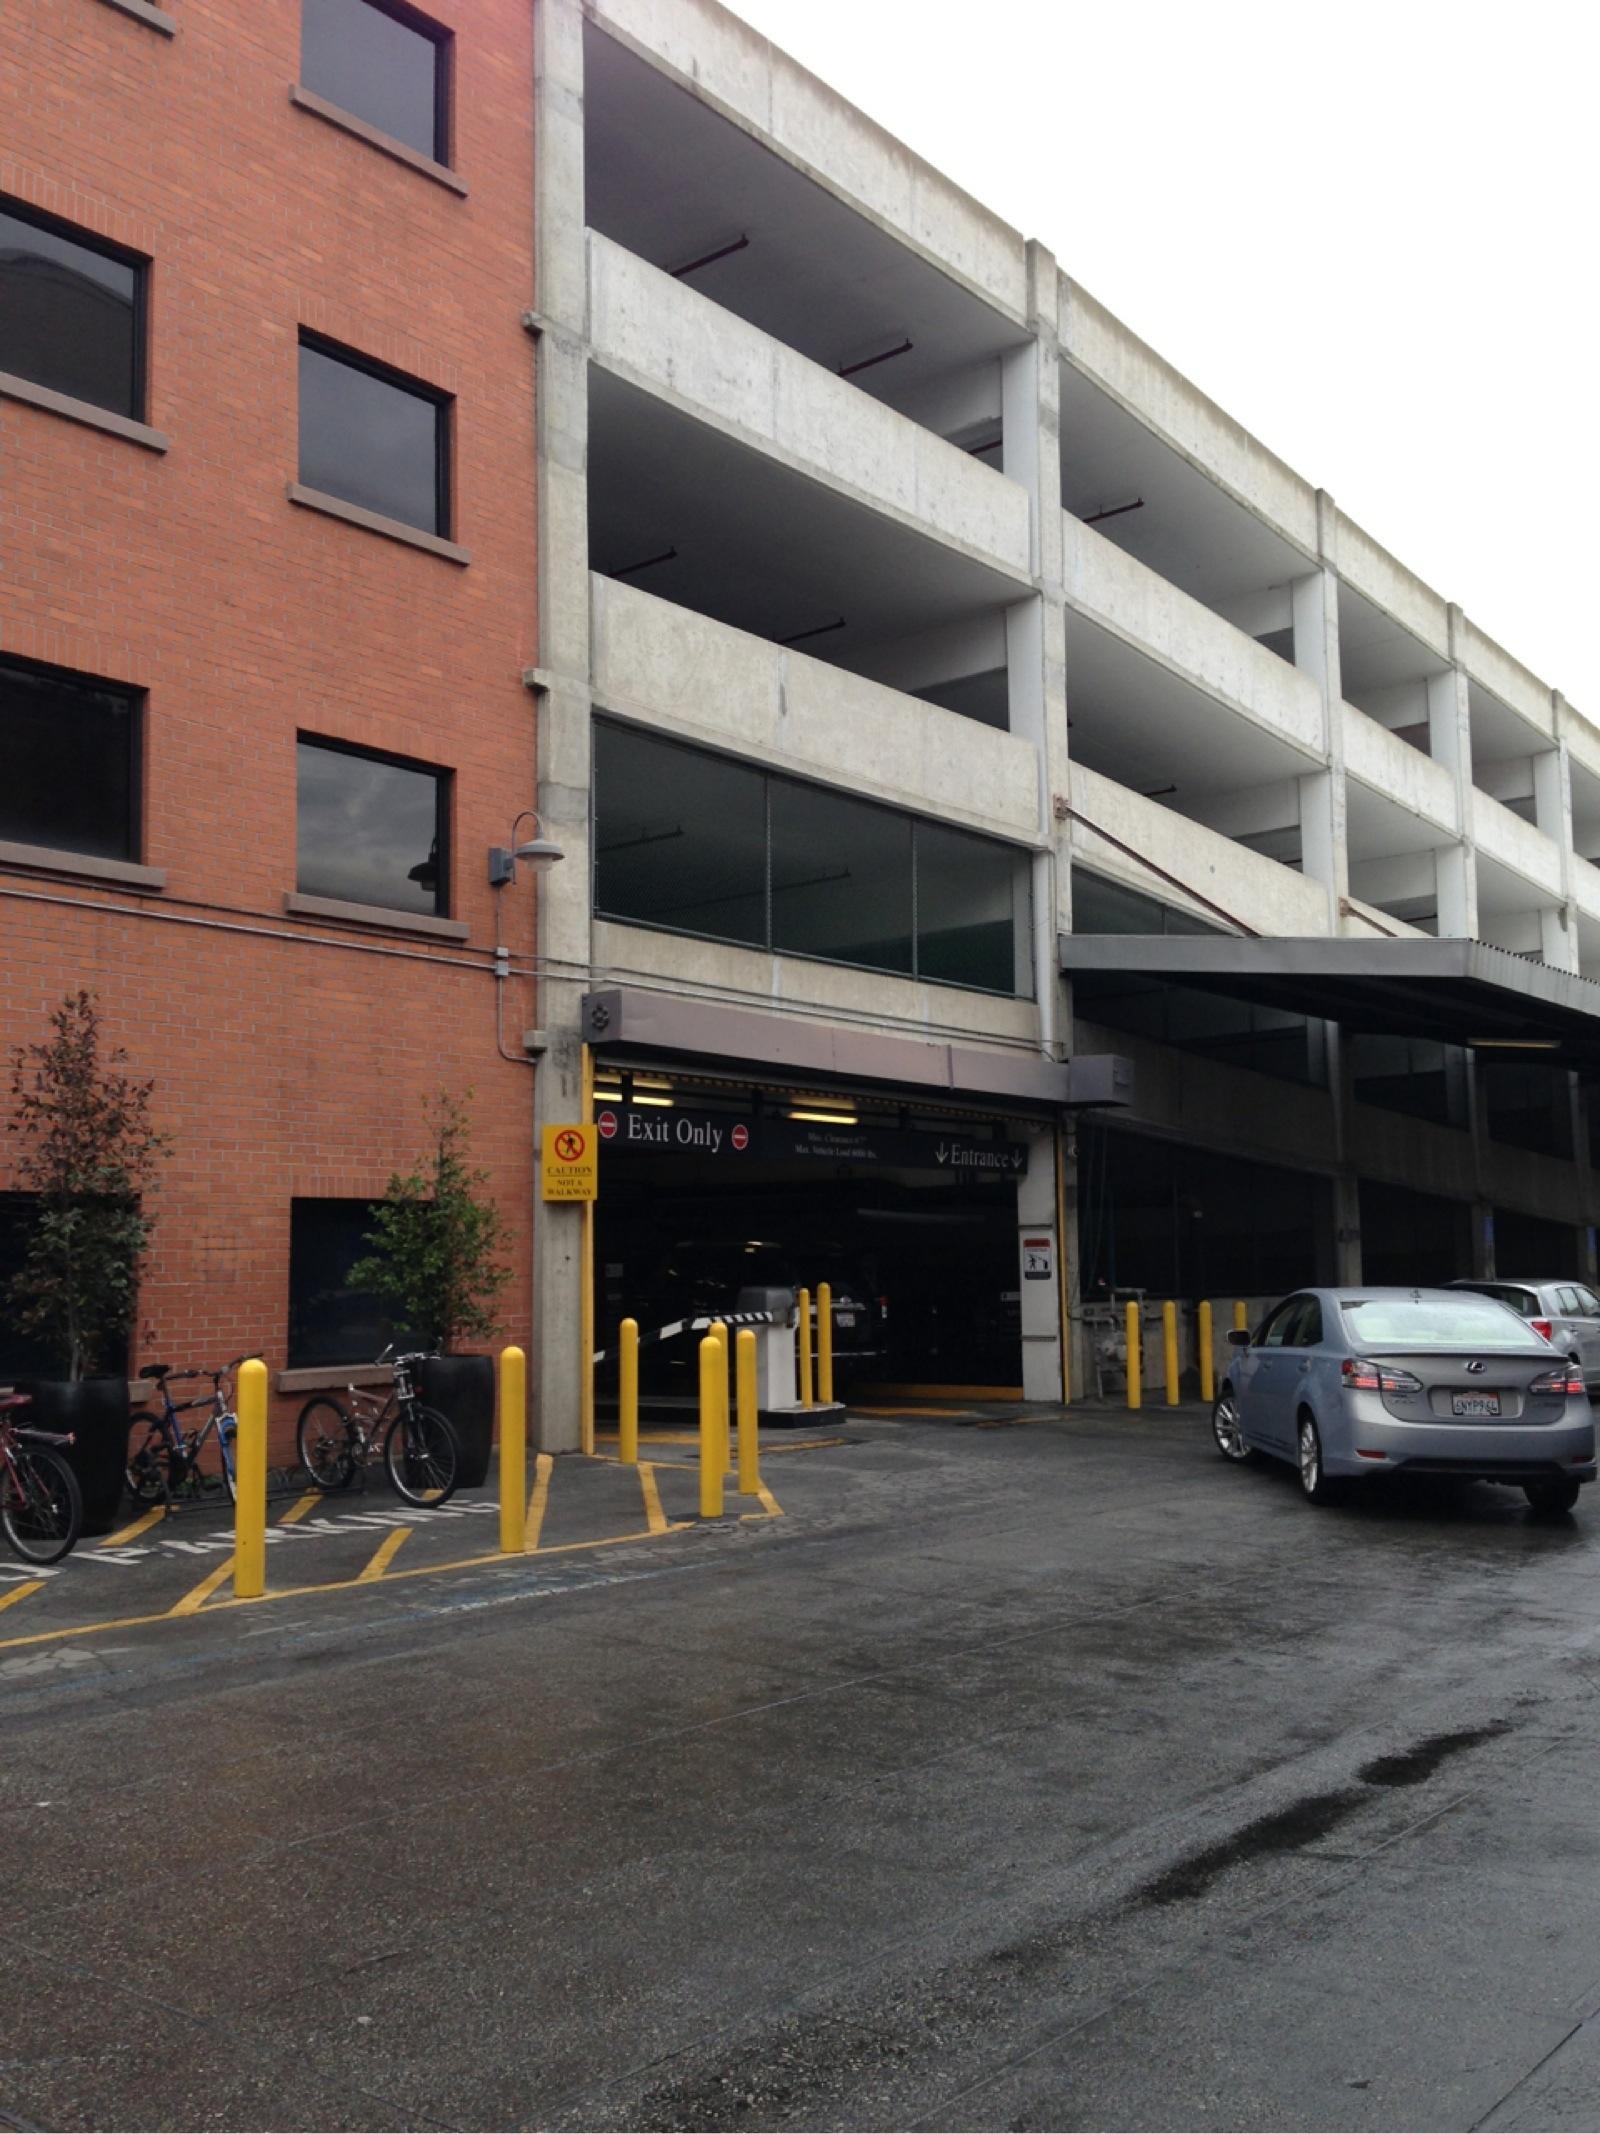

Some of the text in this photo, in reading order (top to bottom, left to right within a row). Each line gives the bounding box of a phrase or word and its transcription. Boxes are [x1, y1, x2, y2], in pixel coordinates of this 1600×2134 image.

[627, 1112, 723, 1153] Exit Only
[950, 1143, 1009, 1169] Entrance
[546, 1166, 593, 1175] CAUTION
[556, 1179, 574, 1187] NOT
[546, 1187, 592, 1197] WALKWAY
